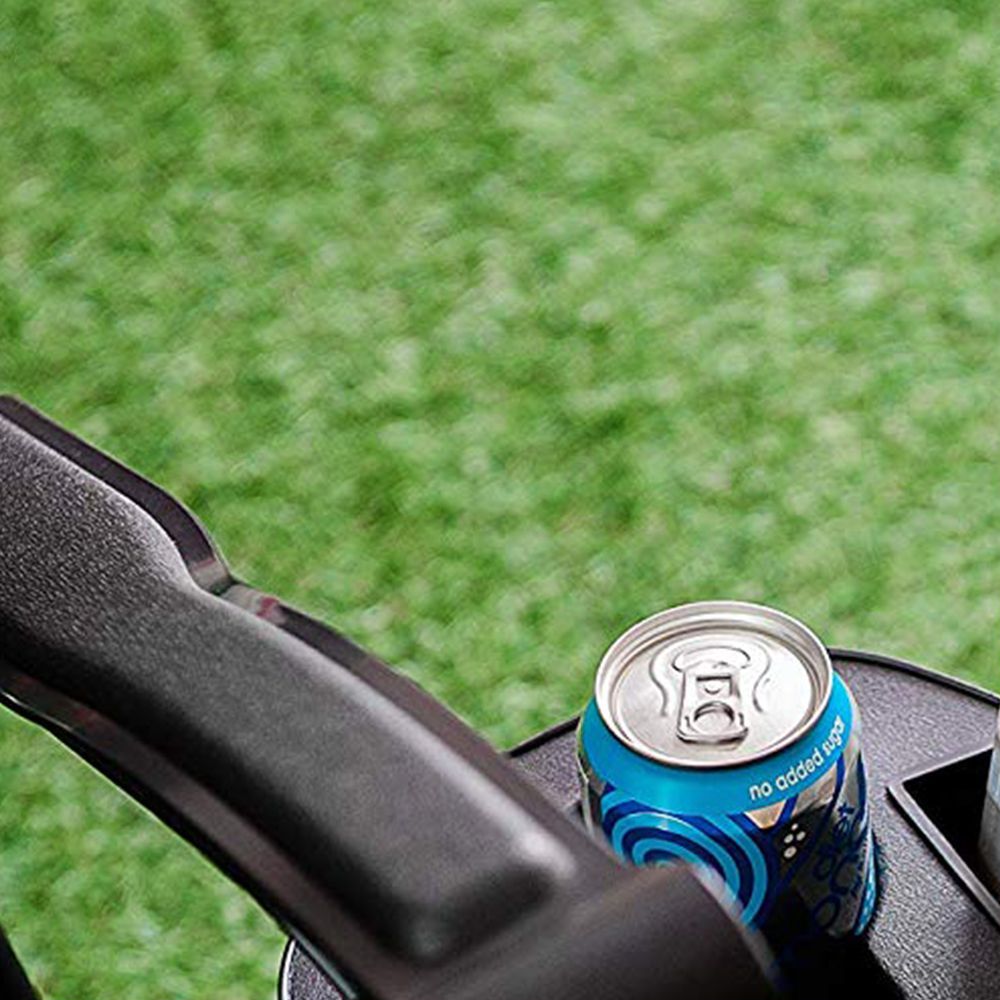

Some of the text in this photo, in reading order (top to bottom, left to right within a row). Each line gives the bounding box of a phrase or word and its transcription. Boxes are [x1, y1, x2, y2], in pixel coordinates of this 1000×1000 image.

[749, 715, 845, 800] no added sugar
